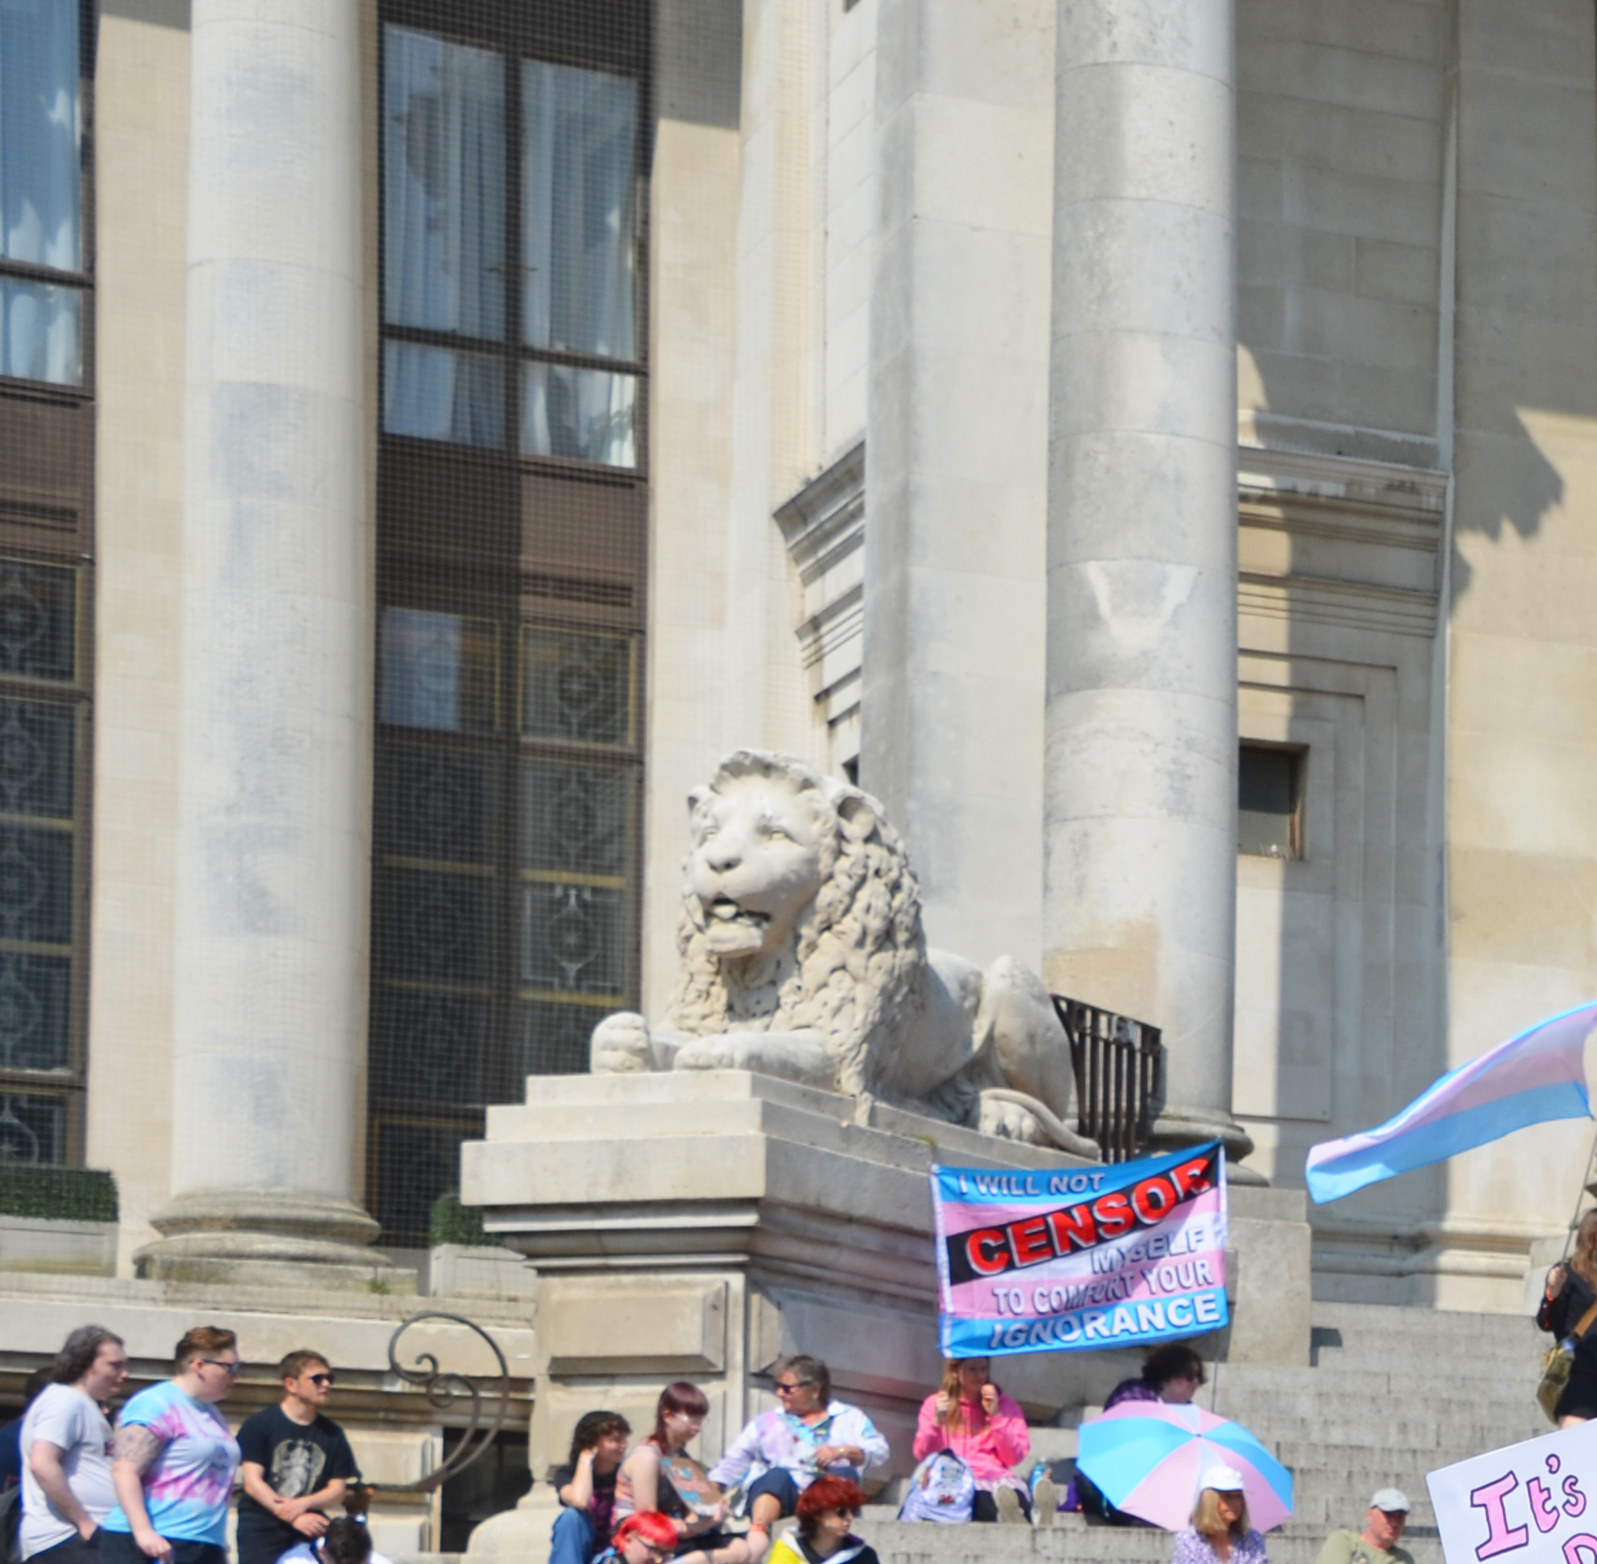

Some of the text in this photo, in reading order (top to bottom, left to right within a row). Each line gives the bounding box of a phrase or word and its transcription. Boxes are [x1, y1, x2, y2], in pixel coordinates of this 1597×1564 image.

[959, 1173, 1106, 1196] I WILL NOT
[966, 1158, 1211, 1275] CENSOR
[1091, 1228, 1206, 1275] MYSELF
[992, 1259, 1213, 1315] TO COMFORT YOUR
[990, 1293, 1220, 1349] IGNORANCE
[1470, 1453, 1587, 1562] It's
